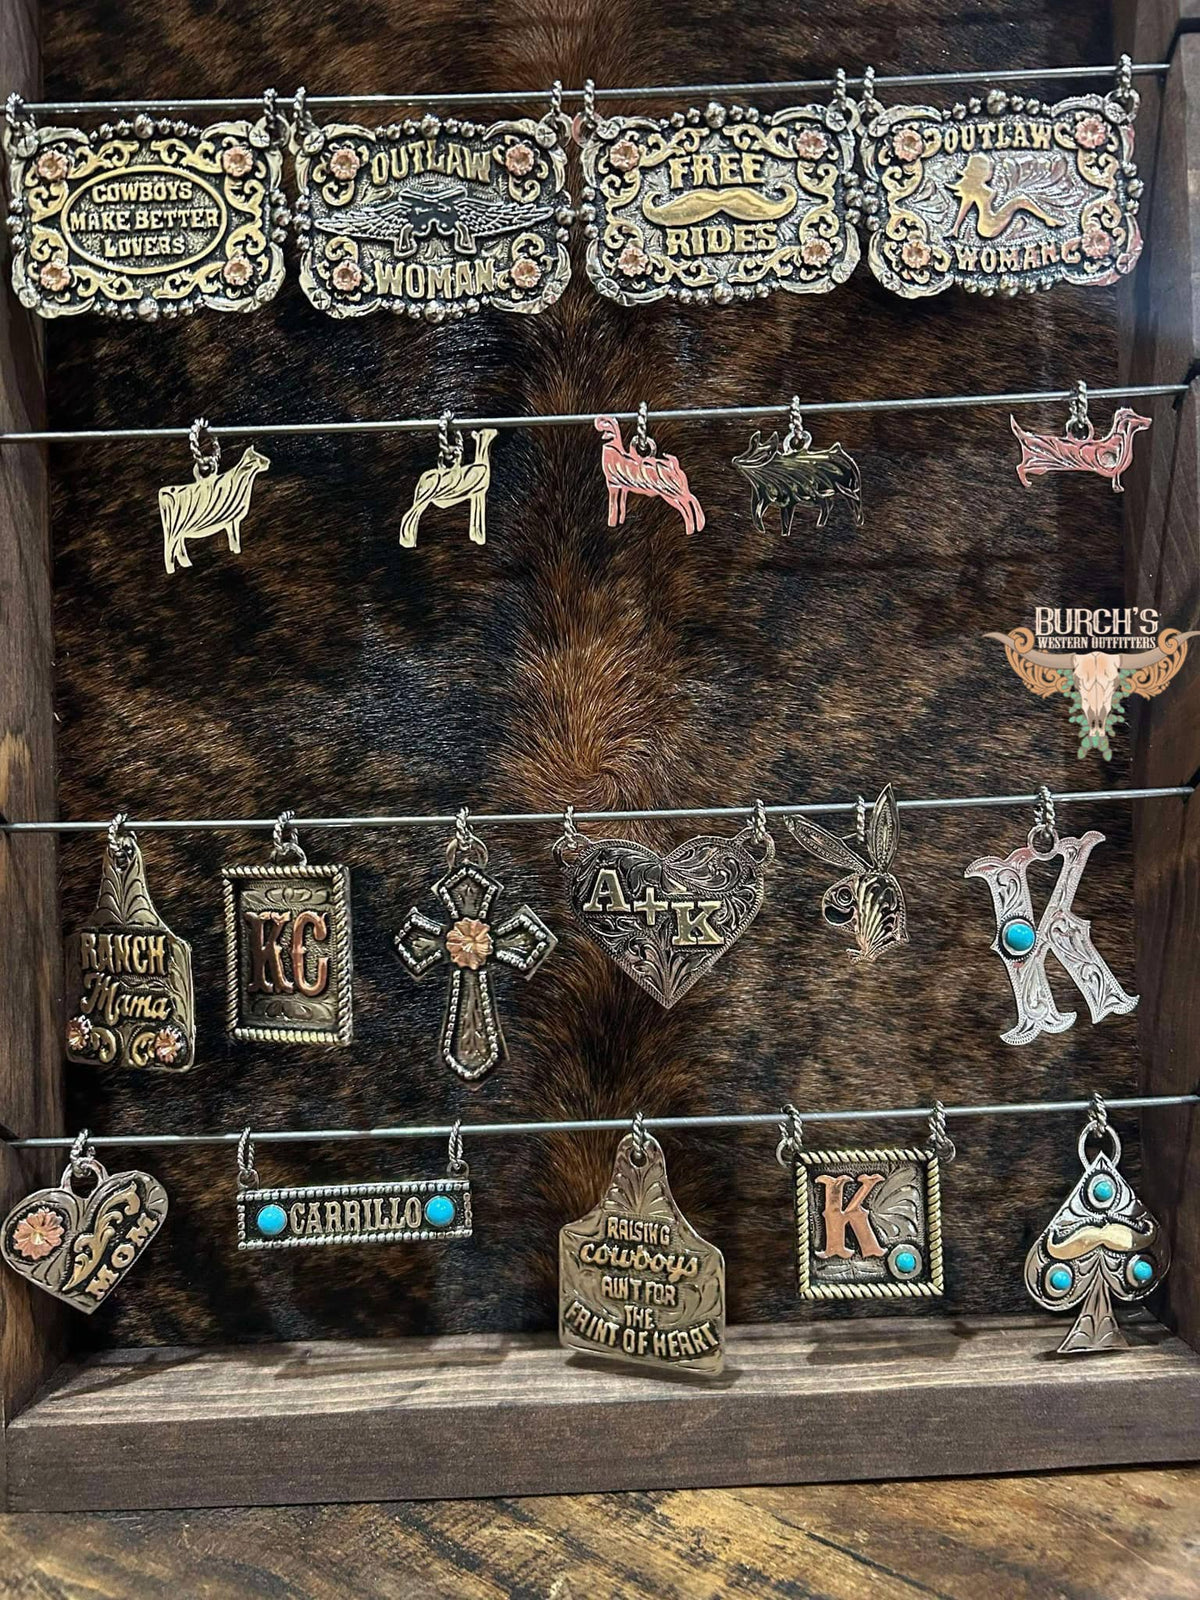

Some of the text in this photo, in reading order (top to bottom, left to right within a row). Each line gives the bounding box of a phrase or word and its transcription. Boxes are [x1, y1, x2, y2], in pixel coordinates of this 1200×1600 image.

[943, 122, 1051, 152] OUTLAW
[371, 140, 493, 185] OUTLAW
[669, 152, 766, 189] FREE
[92, 181, 193, 203] COWBOYS
[69, 208, 220, 232] MAKE BETTER
[103, 235, 186, 258] LOVERS
[665, 223, 778, 256] RIDES
[954, 240, 1058, 273] WOMAN
[374, 258, 496, 300] WOMAN
[80, 932, 168, 975] RANCH
[245, 910, 329, 997] KC
[80, 971, 172, 1026] Mama
[289, 1196, 423, 1235] CARRILLO
[606, 1216, 671, 1246] RAISING
[814, 1173, 888, 1259] K
[85, 1212, 158, 1300] MOM
[644, 1281, 676, 1307] FOR
[564, 1300, 720, 1358] FAINT OF HEART
[623, 1304, 656, 1331] THE
